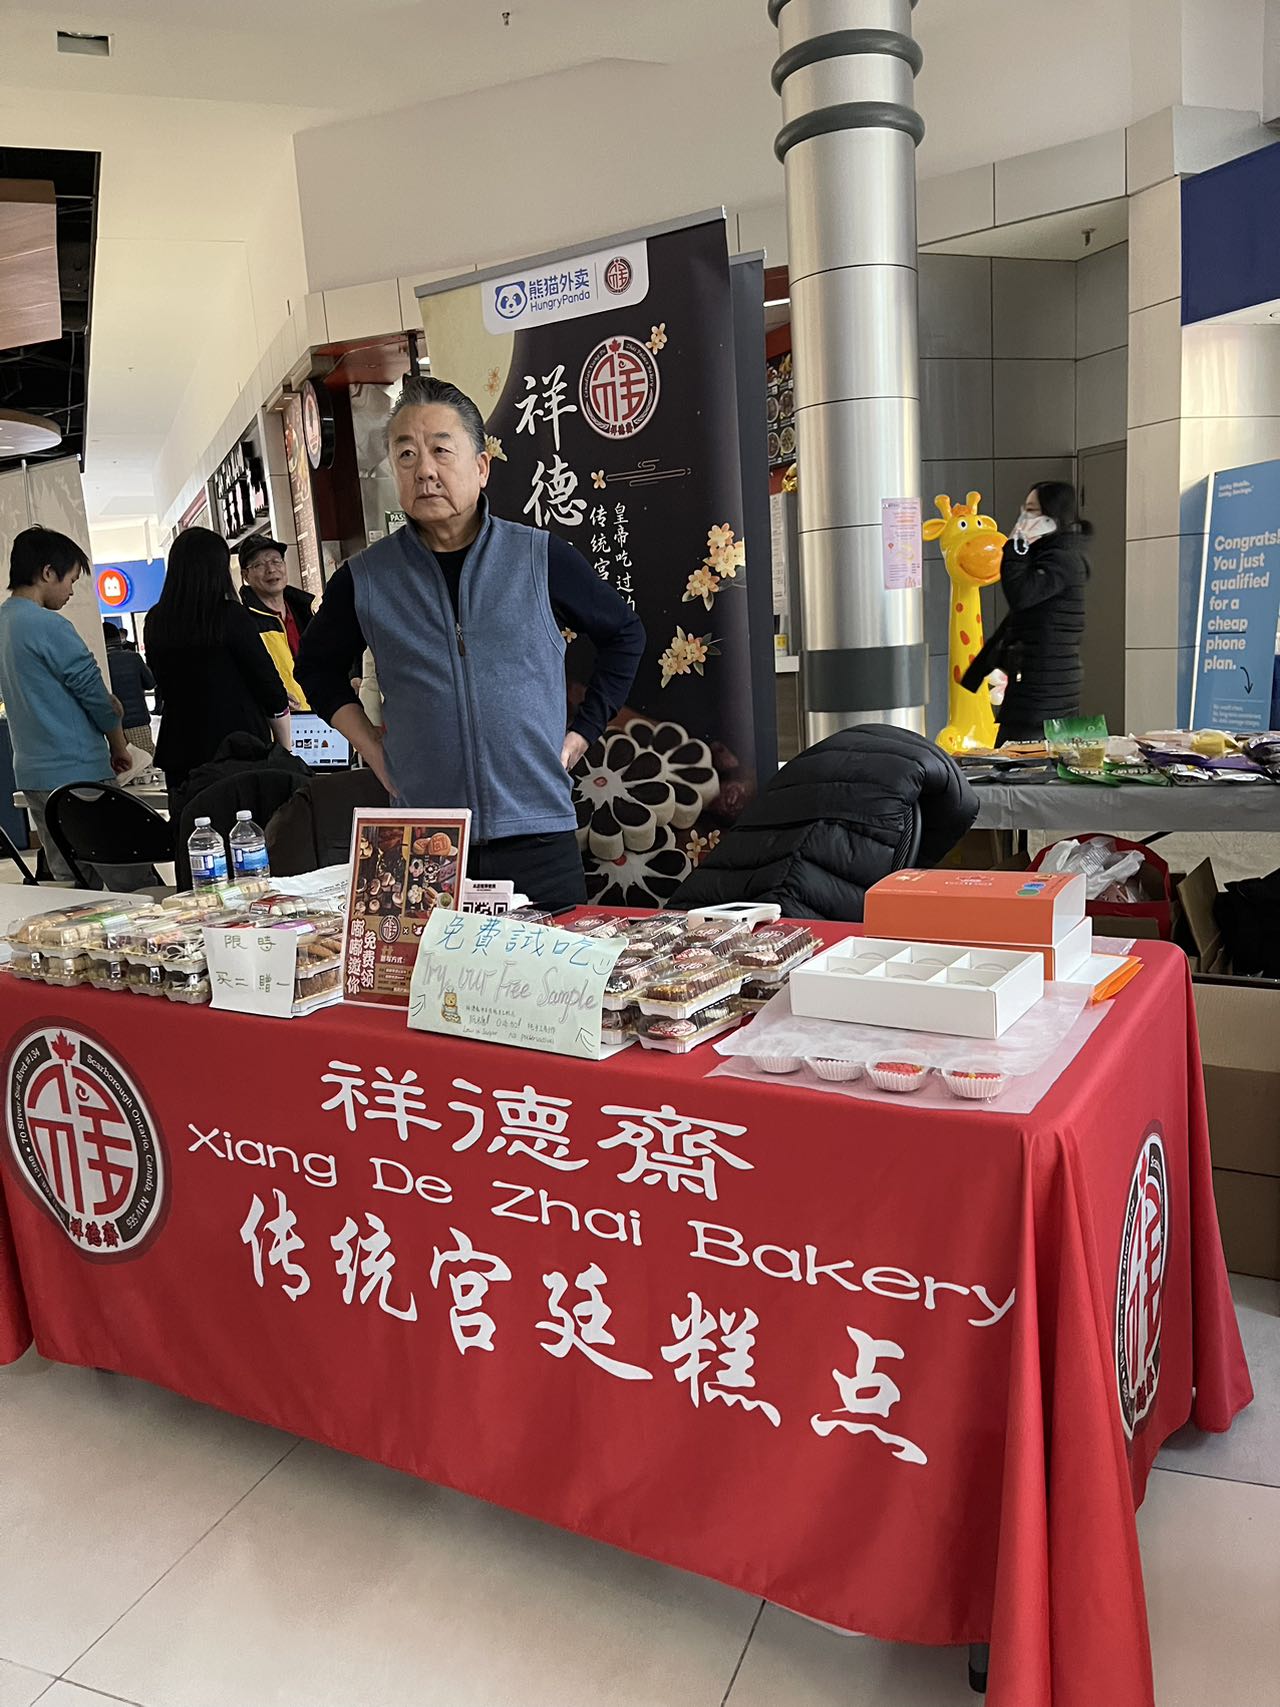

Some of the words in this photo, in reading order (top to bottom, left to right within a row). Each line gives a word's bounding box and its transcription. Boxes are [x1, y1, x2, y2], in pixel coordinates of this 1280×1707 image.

[529, 268, 590, 300] 熊猫外卖
[530, 290, 591, 312] HungryPanda
[515, 364, 588, 545] 祥德
[589, 504, 611, 580] 传统宫
[1214, 529, 1280, 552] Congrats!
[1213, 556, 1237, 571] You
[1239, 552, 1265, 572] just
[1211, 572, 1270, 594] qualified
[1209, 596, 1228, 611] for
[1230, 599, 1240, 610] a
[1207, 616, 1249, 632] cheap
[1206, 636, 1247, 654] phone
[1204, 658, 1237, 673] plan.
[436, 915, 595, 966] 免費試吃
[360, 931, 377, 989] 免费领
[494, 960, 533, 1004] Free
[537, 966, 600, 1025] Sample
[15, 1062, 28, 1082] Blvd
[87, 1053, 133, 1109] Scarborough
[321, 1060, 755, 1201] 祥德齋
[187, 1122, 338, 1189] Xiang
[369, 1157, 453, 1204] De
[491, 1180, 643, 1247] Zhai
[687, 1219, 1017, 1328] Bakery
[239, 1187, 928, 1466] 传统宫廷糕点
